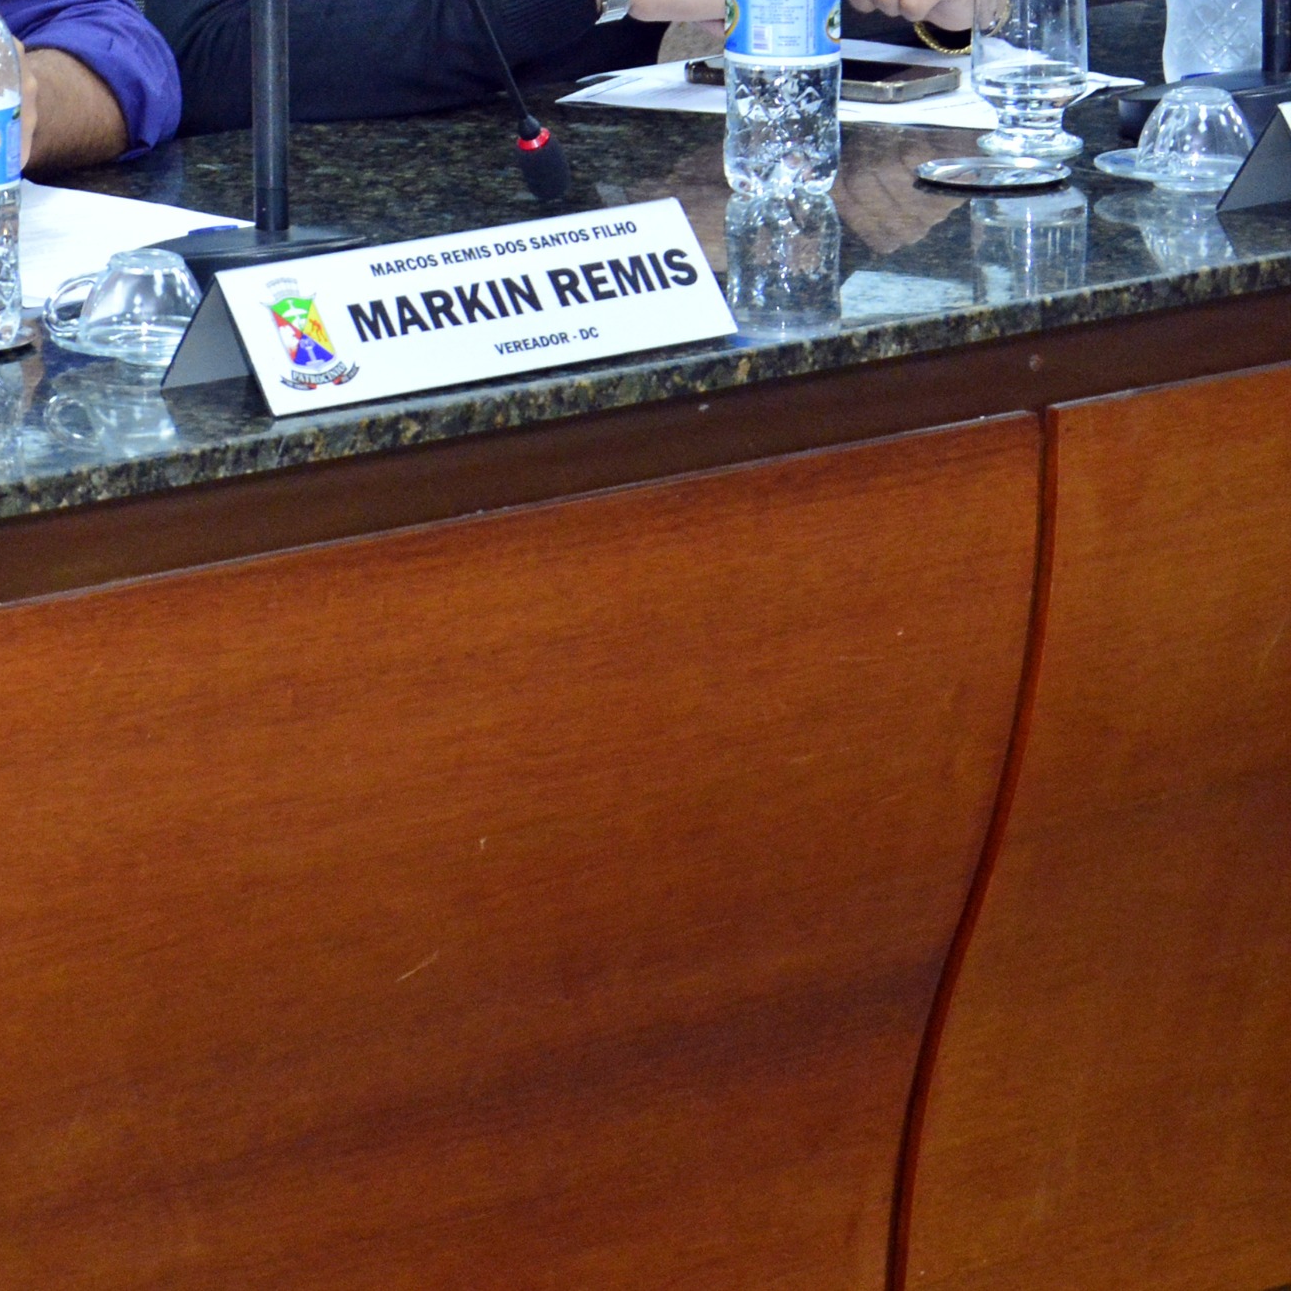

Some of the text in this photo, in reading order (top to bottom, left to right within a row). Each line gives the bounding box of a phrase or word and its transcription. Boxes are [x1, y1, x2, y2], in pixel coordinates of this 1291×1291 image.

[369, 221, 637, 277] MARCOS REMIS DOS SANTOS FILHO
[347, 248, 699, 343] MARKIN REMIS
[494, 331, 570, 356] VEREADOR
[579, 326, 599, 341] DC
